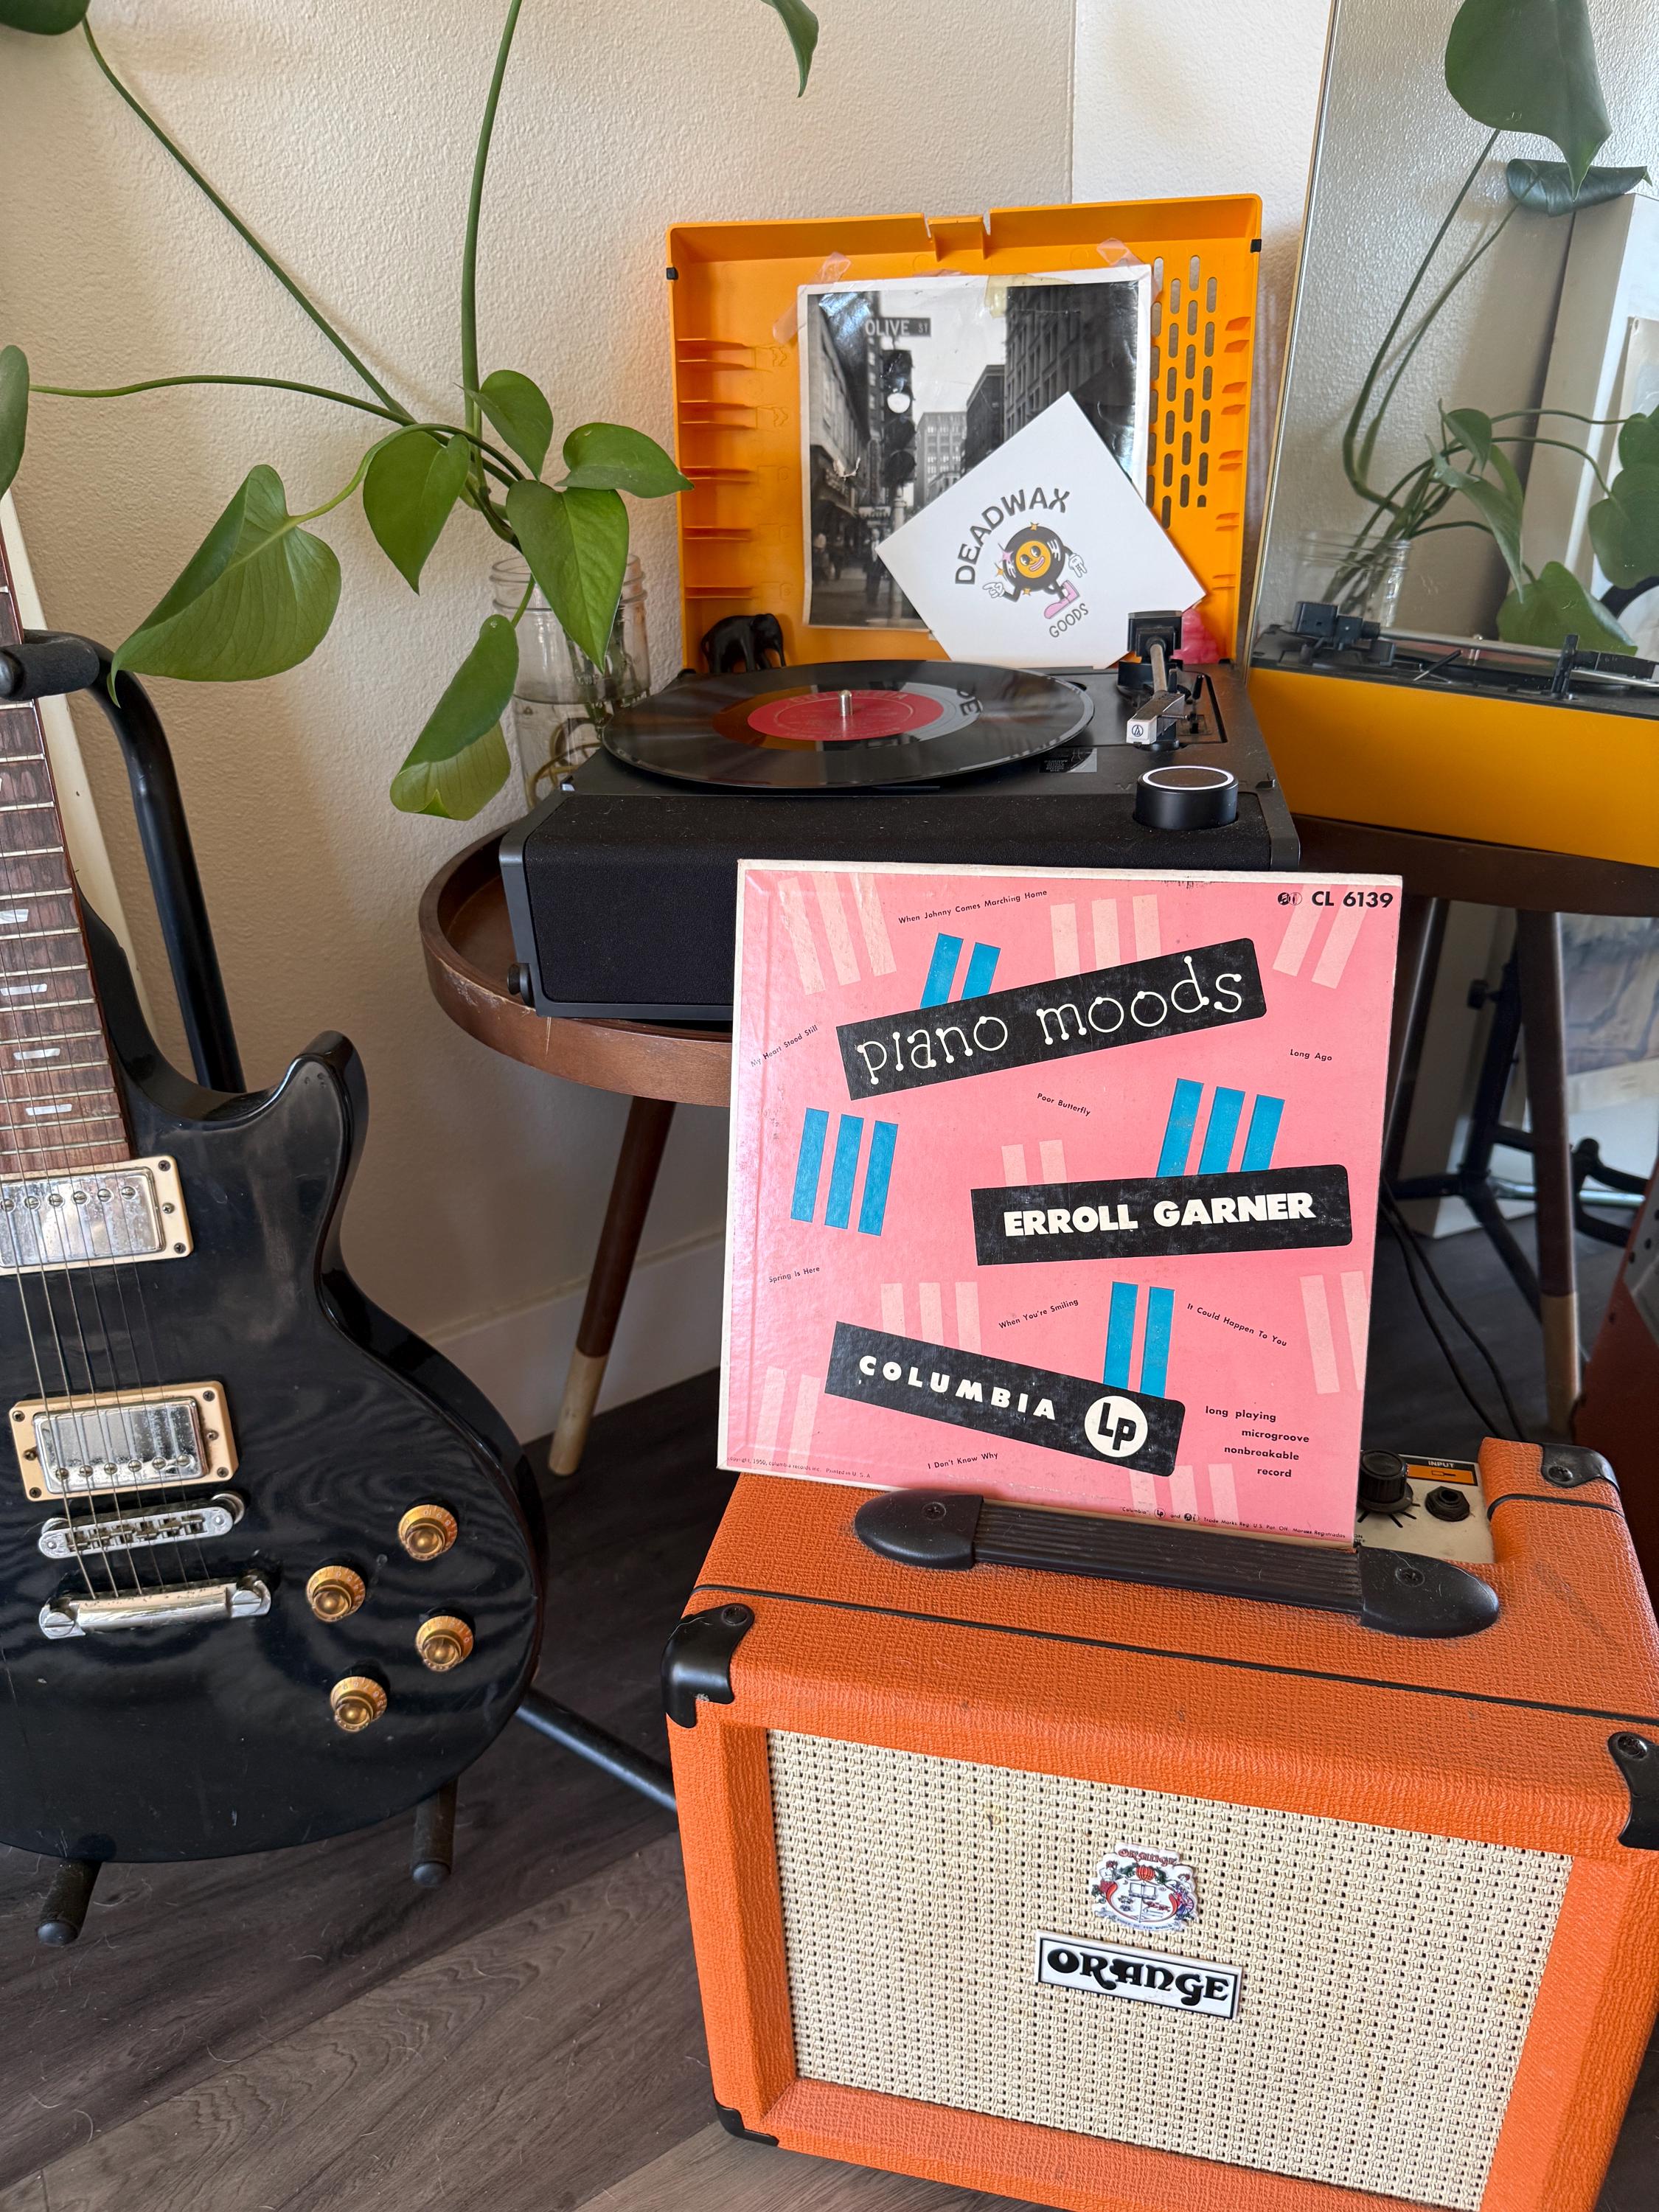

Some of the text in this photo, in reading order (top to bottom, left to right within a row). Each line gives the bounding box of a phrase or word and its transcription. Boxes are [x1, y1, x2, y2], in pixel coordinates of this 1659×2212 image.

[865, 319, 928, 336] OLIVE ST
[955, 487, 1070, 585] DEADWAX
[1048, 603, 1088, 638] GOODS
[898, 890, 1047, 924] When Johnny Comes Marching Home
[1312, 891, 1394, 908] CL 6139
[857, 956, 1242, 1085] piano moods
[762, 1046, 782, 1060] Heart
[783, 1033, 803, 1048] Stood
[804, 1024, 818, 1036] Still
[1290, 1048, 1332, 1062] Long Ago
[1037, 1093, 1091, 1117] Poor Butterfly
[1004, 1192, 1317, 1237] ERROLL GARNER
[768, 1273, 792, 1284] Spring
[803, 1267, 821, 1275] Here
[998, 1299, 1079, 1329] When You're Smiling
[1197, 1307, 1221, 1321] Could
[1223, 1316, 1254, 1334] Happen
[1258, 1330, 1267, 1339] To
[1272, 1335, 1287, 1346] You
[858, 1355, 1056, 1420] COLUMBIA
[1205, 1405, 1276, 1423] long playing
[1242, 1429, 1310, 1443] microgroove
[933, 1459, 953, 1468] Don't
[956, 1456, 978, 1464] Know
[981, 1452, 998, 1460] Why
[1224, 1447, 1300, 1461] nonbreakable
[1428, 1460, 1455, 1468] INPUT
[1257, 1461, 1293, 1478] record
[1047, 1948, 1230, 2006] ORANGE
